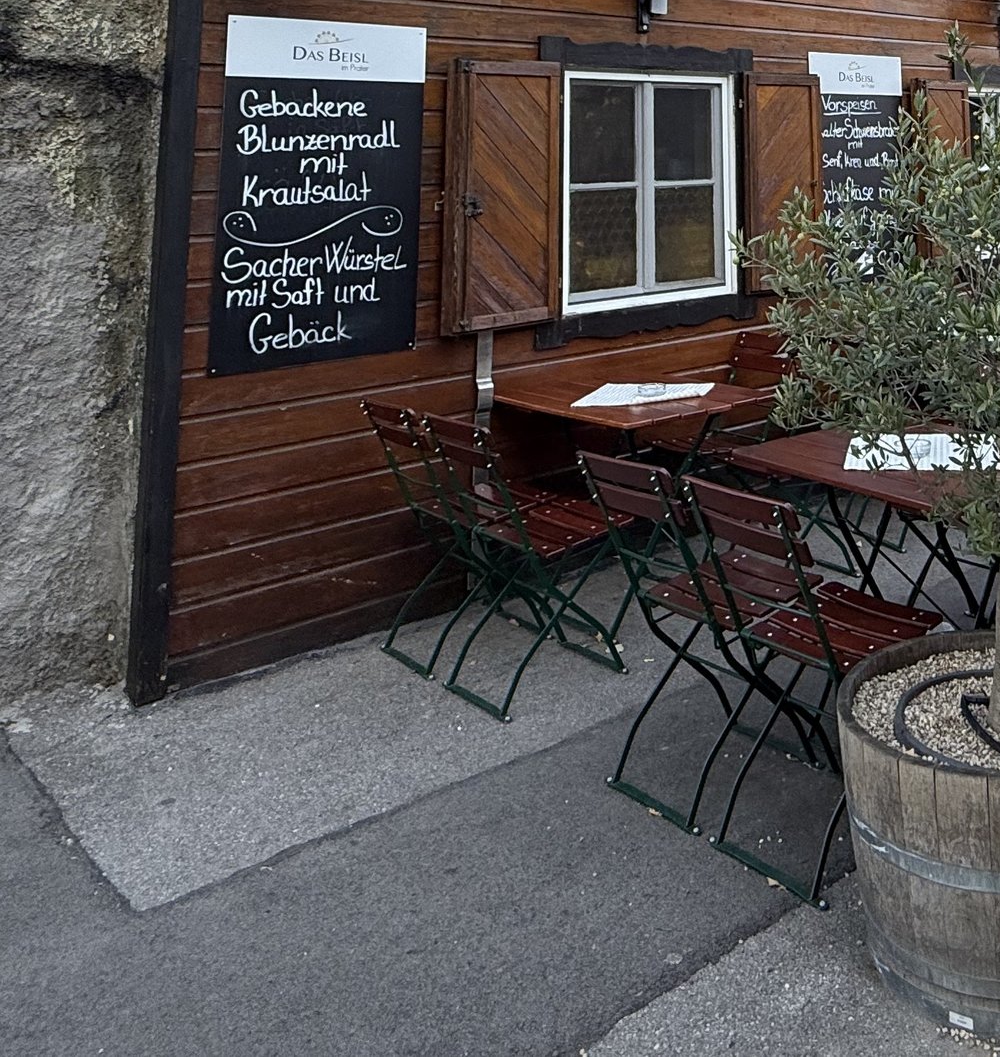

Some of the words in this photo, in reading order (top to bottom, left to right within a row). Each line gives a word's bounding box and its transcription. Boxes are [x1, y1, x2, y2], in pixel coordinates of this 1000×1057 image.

[292, 45, 324, 61] DAS
[329, 48, 369, 64] BEISL
[350, 64, 369, 72] Prater
[838, 71, 854, 82] DAS
[855, 72, 874, 83] BEISL
[240, 88, 368, 118] Gebackene
[820, 95, 878, 117] Vorspeisen
[236, 119, 401, 155] Blunzenradl
[847, 139, 864, 150] mit
[299, 152, 348, 175] mit
[864, 152, 880, 167] und
[242, 170, 372, 207] Krautsalat
[220, 246, 323, 284] Sacher
[324, 235, 407, 274] Würstel
[226, 279, 267, 309] mit
[271, 277, 325, 309] Saft
[334, 277, 380, 304] und
[249, 310, 352, 355] Gebäck
